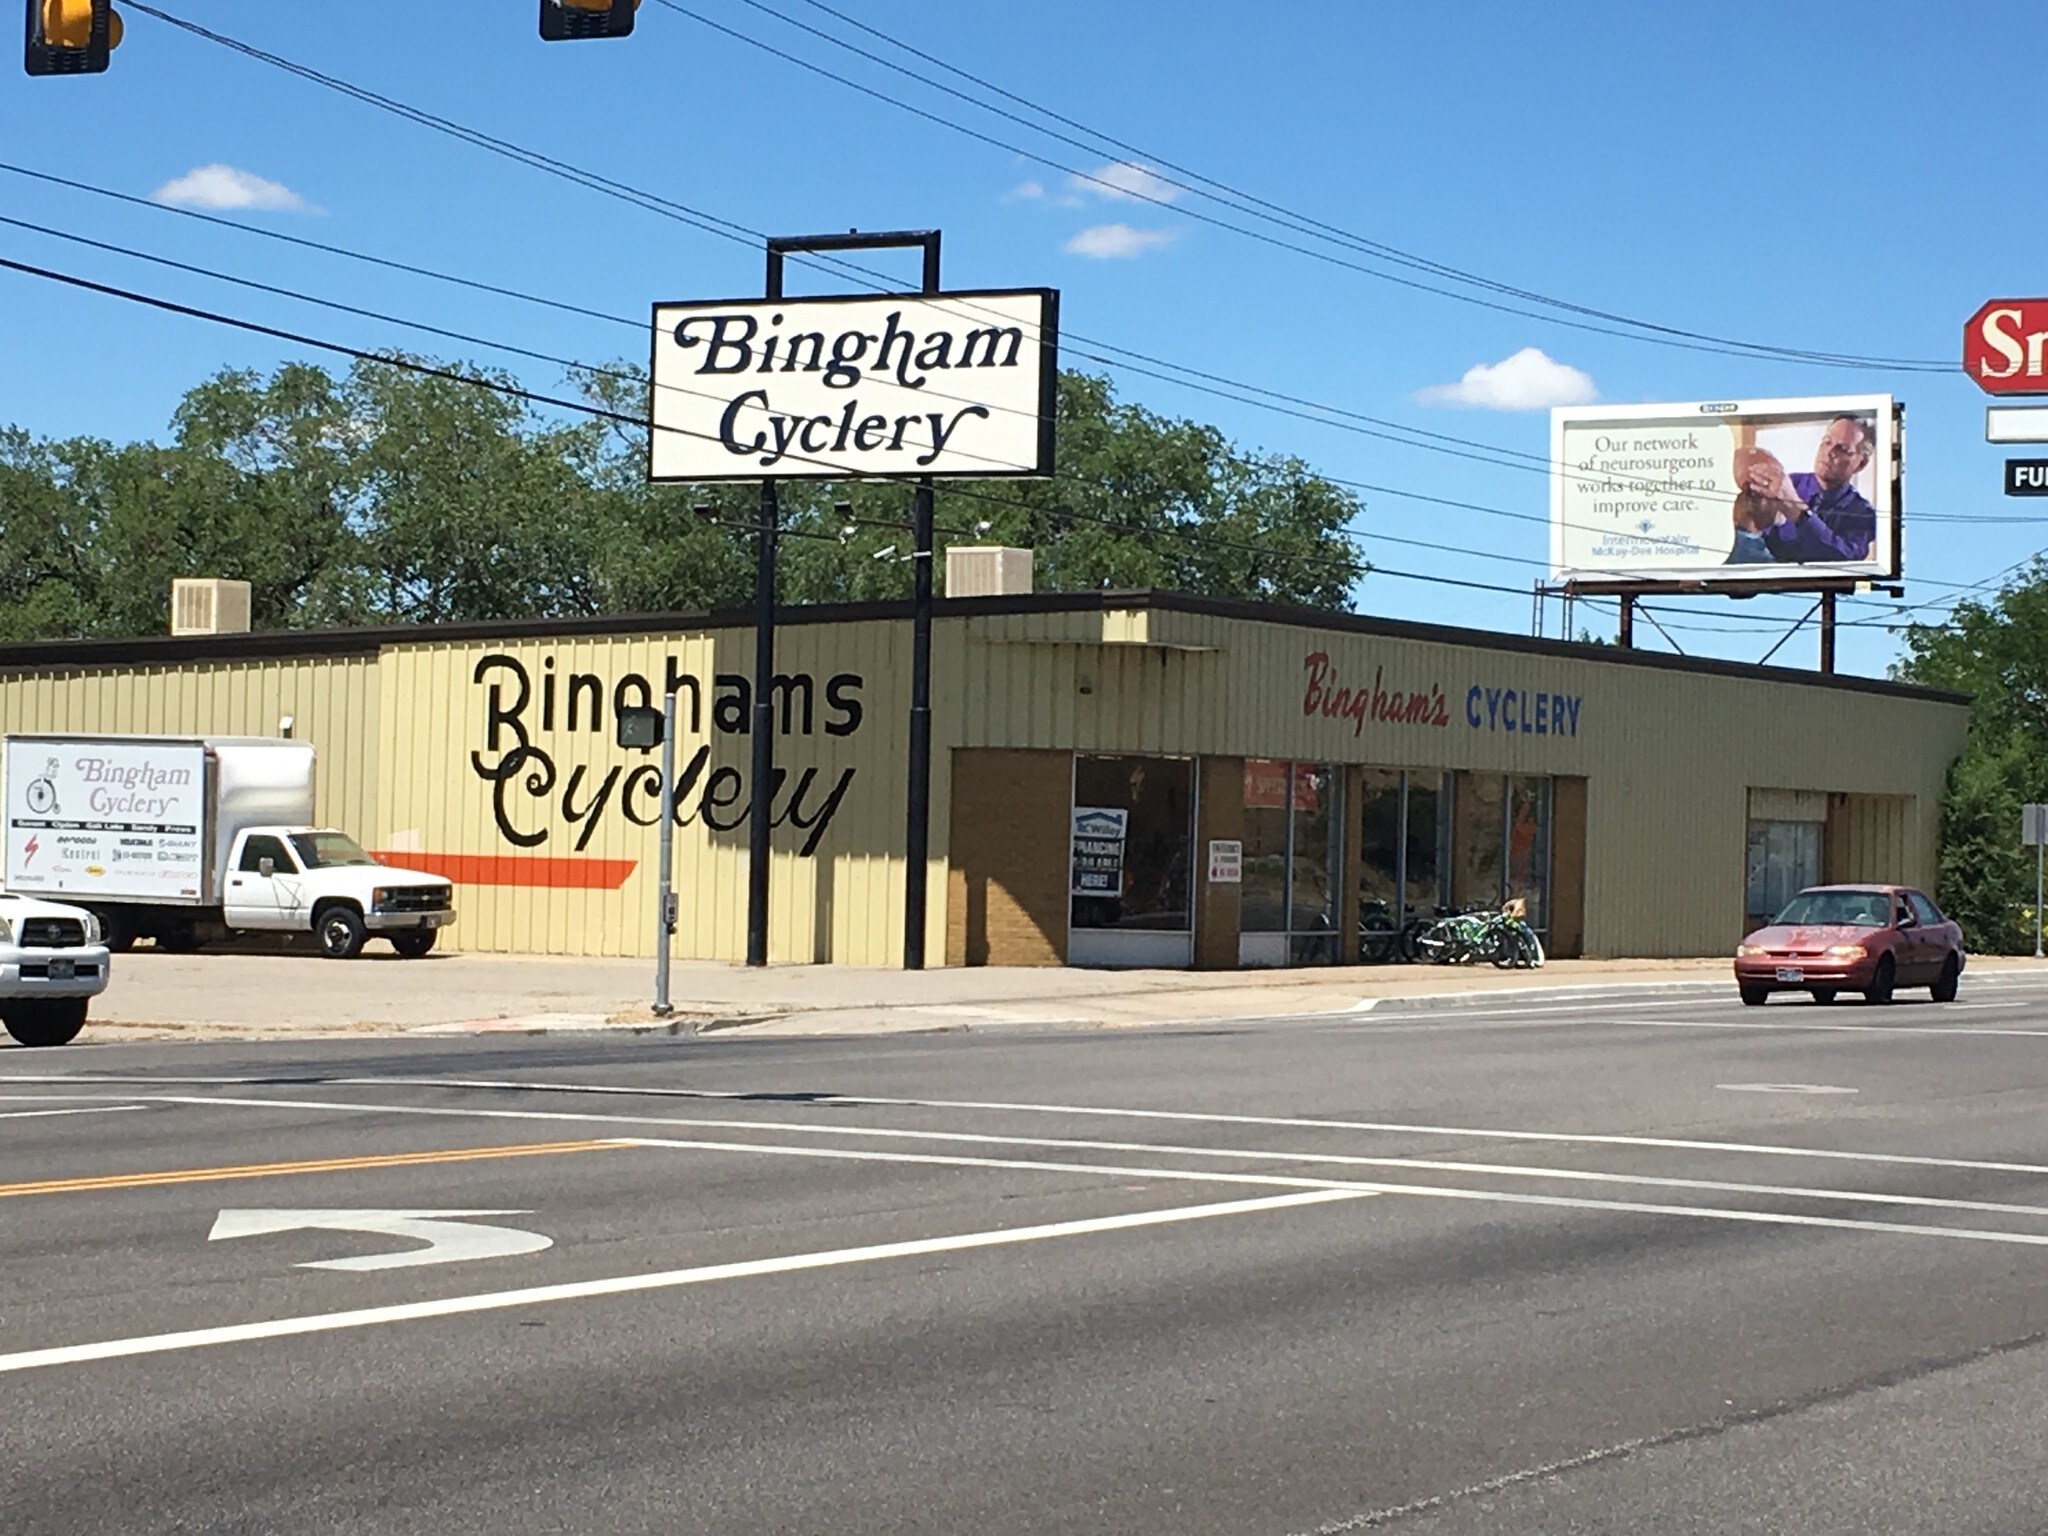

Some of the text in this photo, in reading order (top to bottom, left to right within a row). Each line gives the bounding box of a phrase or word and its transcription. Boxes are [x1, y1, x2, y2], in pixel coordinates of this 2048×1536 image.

[673, 311, 1023, 389] Bingham
[719, 389, 989, 467] Cyclery
[1595, 432, 1699, 452] Our network
[1578, 453, 1715, 475] of neurosurgeons
[1577, 475, 1716, 497] works together to
[1592, 499, 1699, 518] improve care.
[1655, 543, 1700, 557] Hospital
[1304, 651, 1582, 738] Bingham's CYCLERY
[75, 757, 192, 791] Bingham
[89, 787, 180, 818] Cyclery
